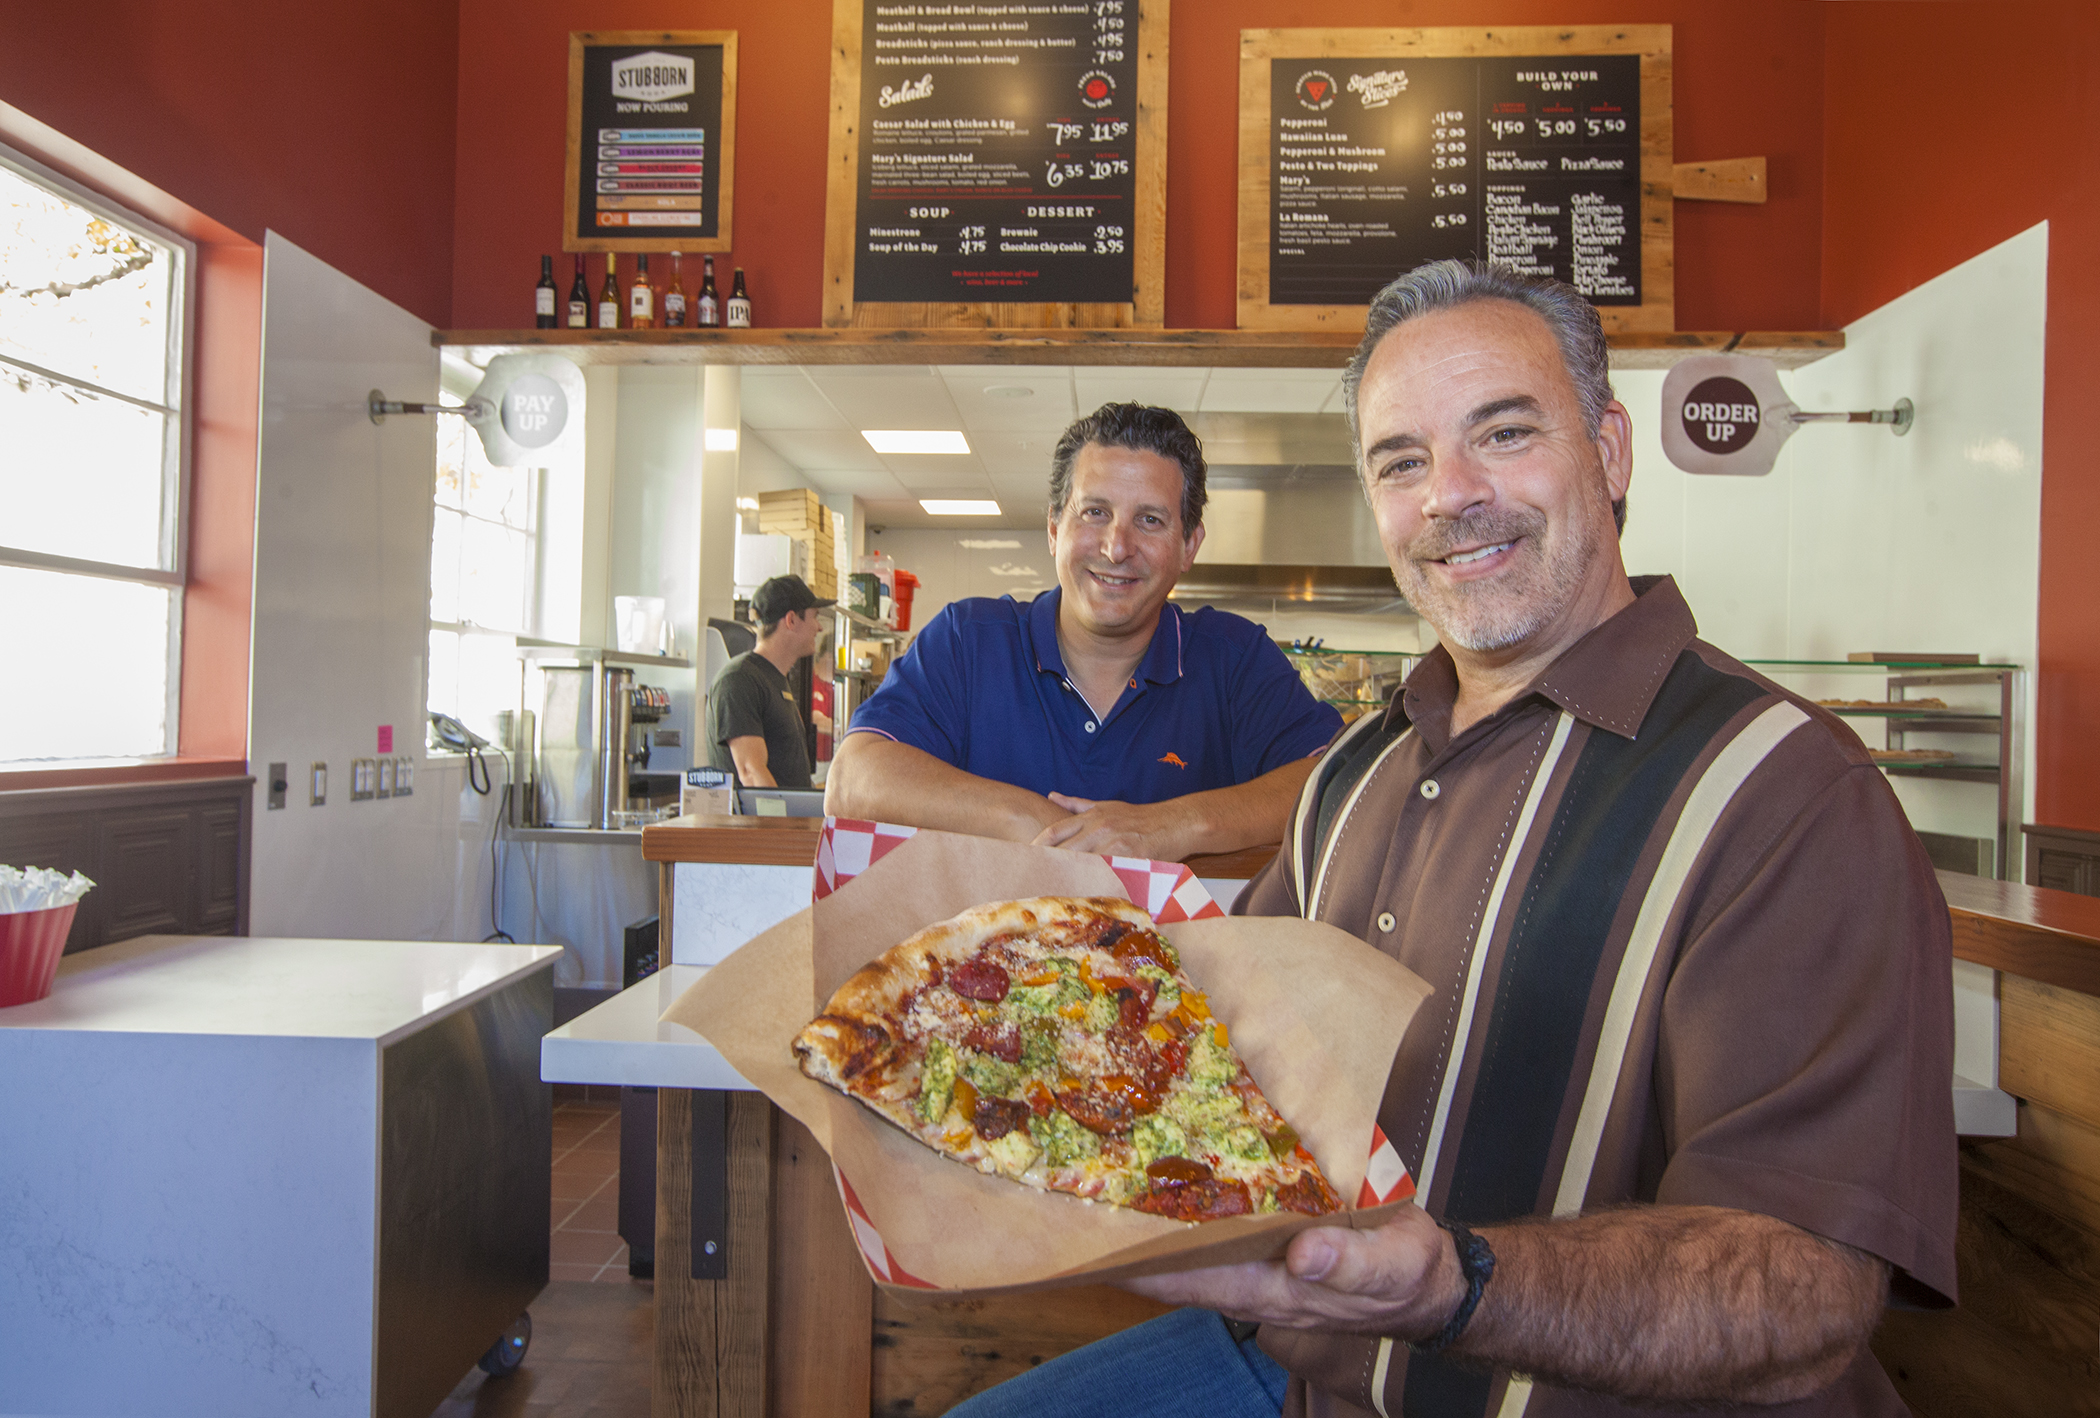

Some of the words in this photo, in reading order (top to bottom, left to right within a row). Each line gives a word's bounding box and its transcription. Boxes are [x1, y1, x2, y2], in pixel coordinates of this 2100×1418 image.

[1008, 5, 1027, 14] with
[948, 22, 967, 31] with
[618, 66, 687, 89] STUBBORN
[1516, 72, 1558, 82] BUILD
[1561, 71, 1599, 82] YOUR
[878, 73, 934, 109] Salads
[1541, 81, 1573, 92] OWN
[617, 102, 642, 113] NOW
[642, 102, 689, 113] POURING
[873, 119, 903, 129] Caesar
[904, 119, 930, 129] Salad
[931, 119, 952, 129] with
[953, 119, 990, 129] Chicken
[1000, 119, 1016, 131] Egg
[1280, 117, 1327, 129] Pepperoni
[1280, 132, 1324, 142] Hawaiian
[1280, 146, 1327, 158] Pepperoni
[1328, 147, 1336, 157] &
[1337, 146, 1386, 156] Mushroom
[903, 153, 947, 165] Signature
[949, 153, 974, 163] Salad
[1280, 161, 1306, 171] Pesto
[1307, 161, 1315, 171] &
[1316, 161, 1336, 171] Two
[1336, 161, 1379, 173] Toppings
[1280, 175, 1311, 187] Mary's
[1486, 193, 1521, 205] Bacon
[909, 207, 951, 218] SOUP
[1027, 206, 1095, 218] DESSERT
[1532, 202, 1560, 215] Bacon
[1279, 213, 1291, 222] La
[1292, 213, 1329, 222] Romana
[869, 228, 921, 237] Minestrone
[1001, 227, 1039, 237] Brownie
[868, 242, 892, 254] Soup
[892, 241, 903, 252] of
[904, 241, 920, 252] the
[921, 242, 939, 254] Day
[1000, 242, 1040, 252] Chocolate
[1040, 242, 1058, 254] Chip
[1059, 242, 1087, 252] Cookie
[730, 306, 750, 322] IPA
[514, 395, 556, 412] PAY
[1683, 402, 1758, 423] ORDER
[519, 414, 548, 431] UP
[1705, 423, 1736, 442] UP
